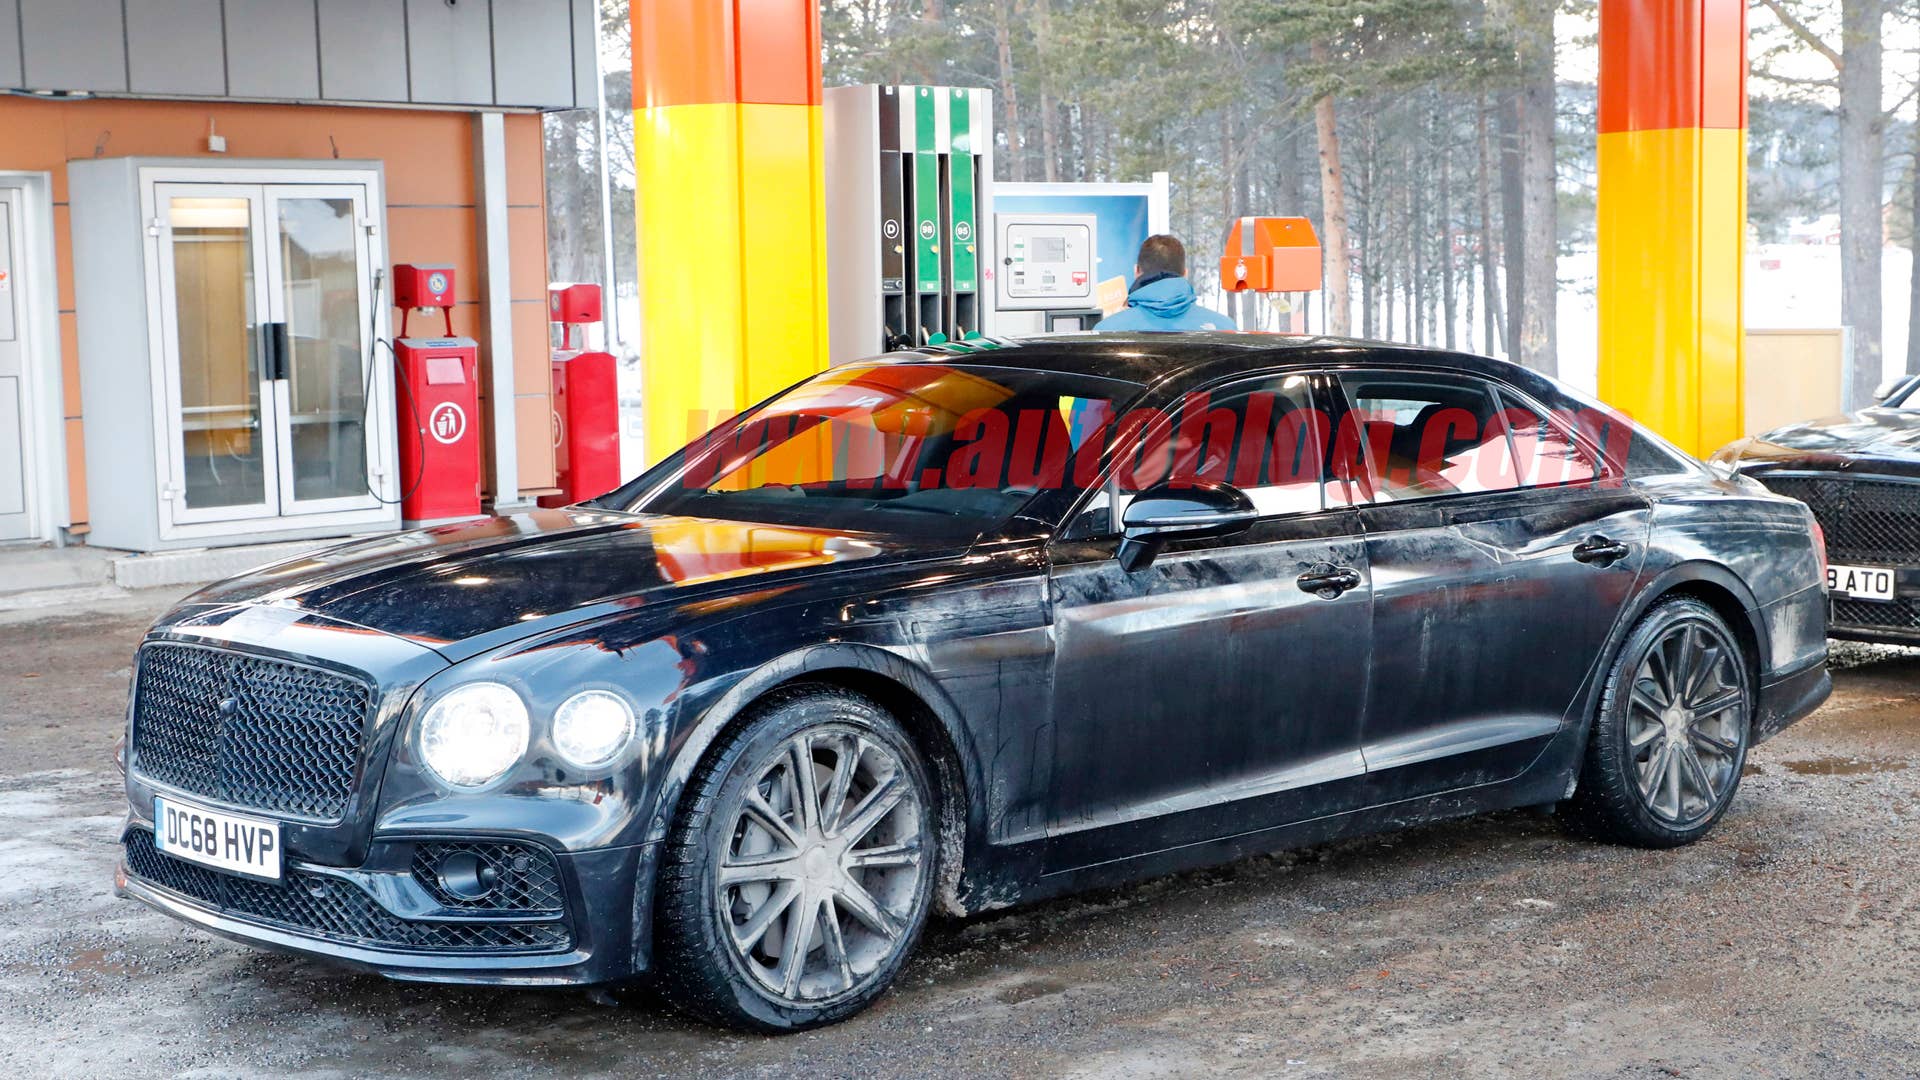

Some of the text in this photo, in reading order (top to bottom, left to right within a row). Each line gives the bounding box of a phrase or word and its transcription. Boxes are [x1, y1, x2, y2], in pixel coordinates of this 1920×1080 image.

[887, 224, 896, 234] D
[958, 226, 968, 235] 95
[167, 806, 274, 866] DC68 HVP
